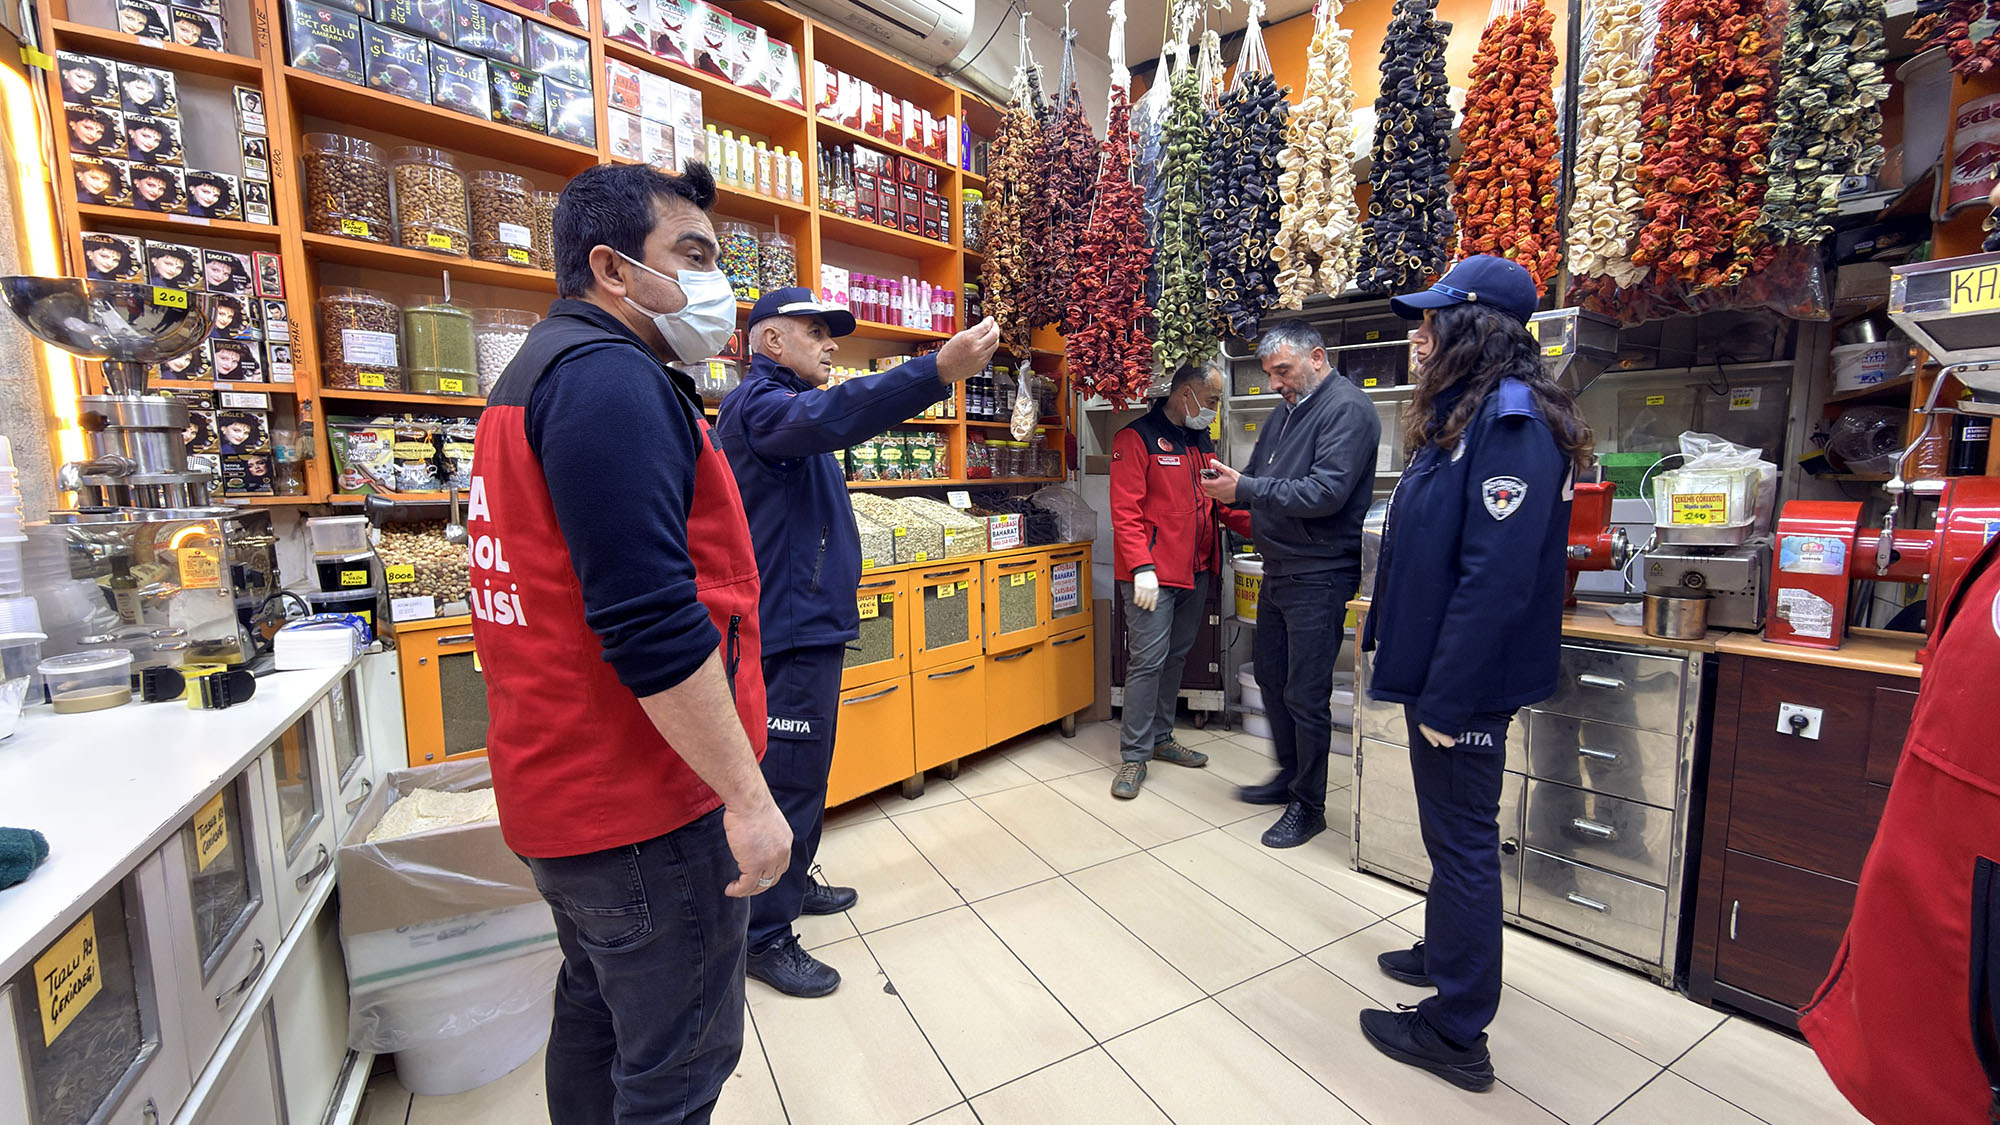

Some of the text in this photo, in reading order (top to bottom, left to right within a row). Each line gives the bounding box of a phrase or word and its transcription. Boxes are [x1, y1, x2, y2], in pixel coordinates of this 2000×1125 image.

[175, 10, 202, 22] EAGLE'S
[297, 11, 312, 19] Has
[256, 8, 269, 48] KAHVE
[296, 17, 355, 39] GCT GÜLLÜ
[311, 29, 343, 42] AMMARA
[207, 253, 233, 263] EAGLE'S
[1953, 267, 2000, 304] KA
[158, 291, 185, 303] 200
[292, 319, 301, 365] KESTANE
[468, 476, 491, 522] A
[992, 528, 1018, 538] BAHARAT
[1054, 570, 1076, 580] BAHARAT
[1246, 577, 1254, 588] EV
[1055, 593, 1076, 603] BAHARAT
[767, 716, 811, 733] ZABITA
[43, 954, 80, 998] TUZLU
